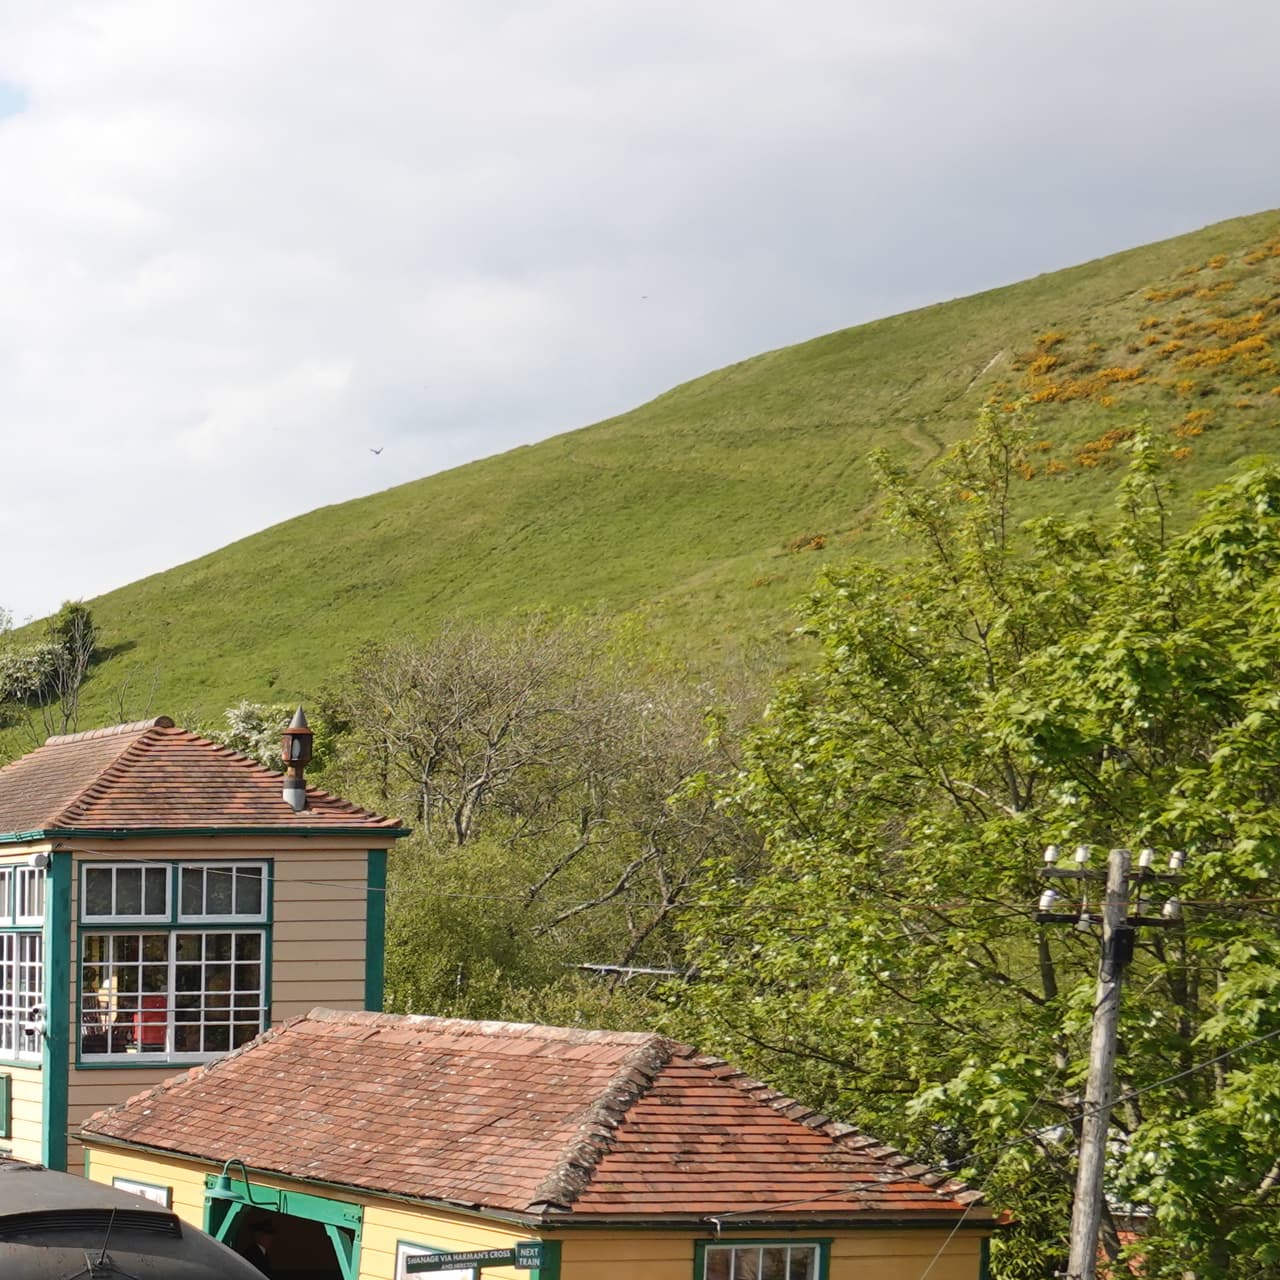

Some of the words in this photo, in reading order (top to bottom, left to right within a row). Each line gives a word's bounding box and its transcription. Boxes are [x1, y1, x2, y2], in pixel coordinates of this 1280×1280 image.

[520, 1247, 539, 1257] NEXT
[407, 1255, 439, 1265] SWANAGE
[440, 1254, 452, 1262] VIA
[453, 1251, 488, 1261] HARMAN'S
[490, 1250, 511, 1258] CROSS
[519, 1258, 540, 1266] TRAIN
